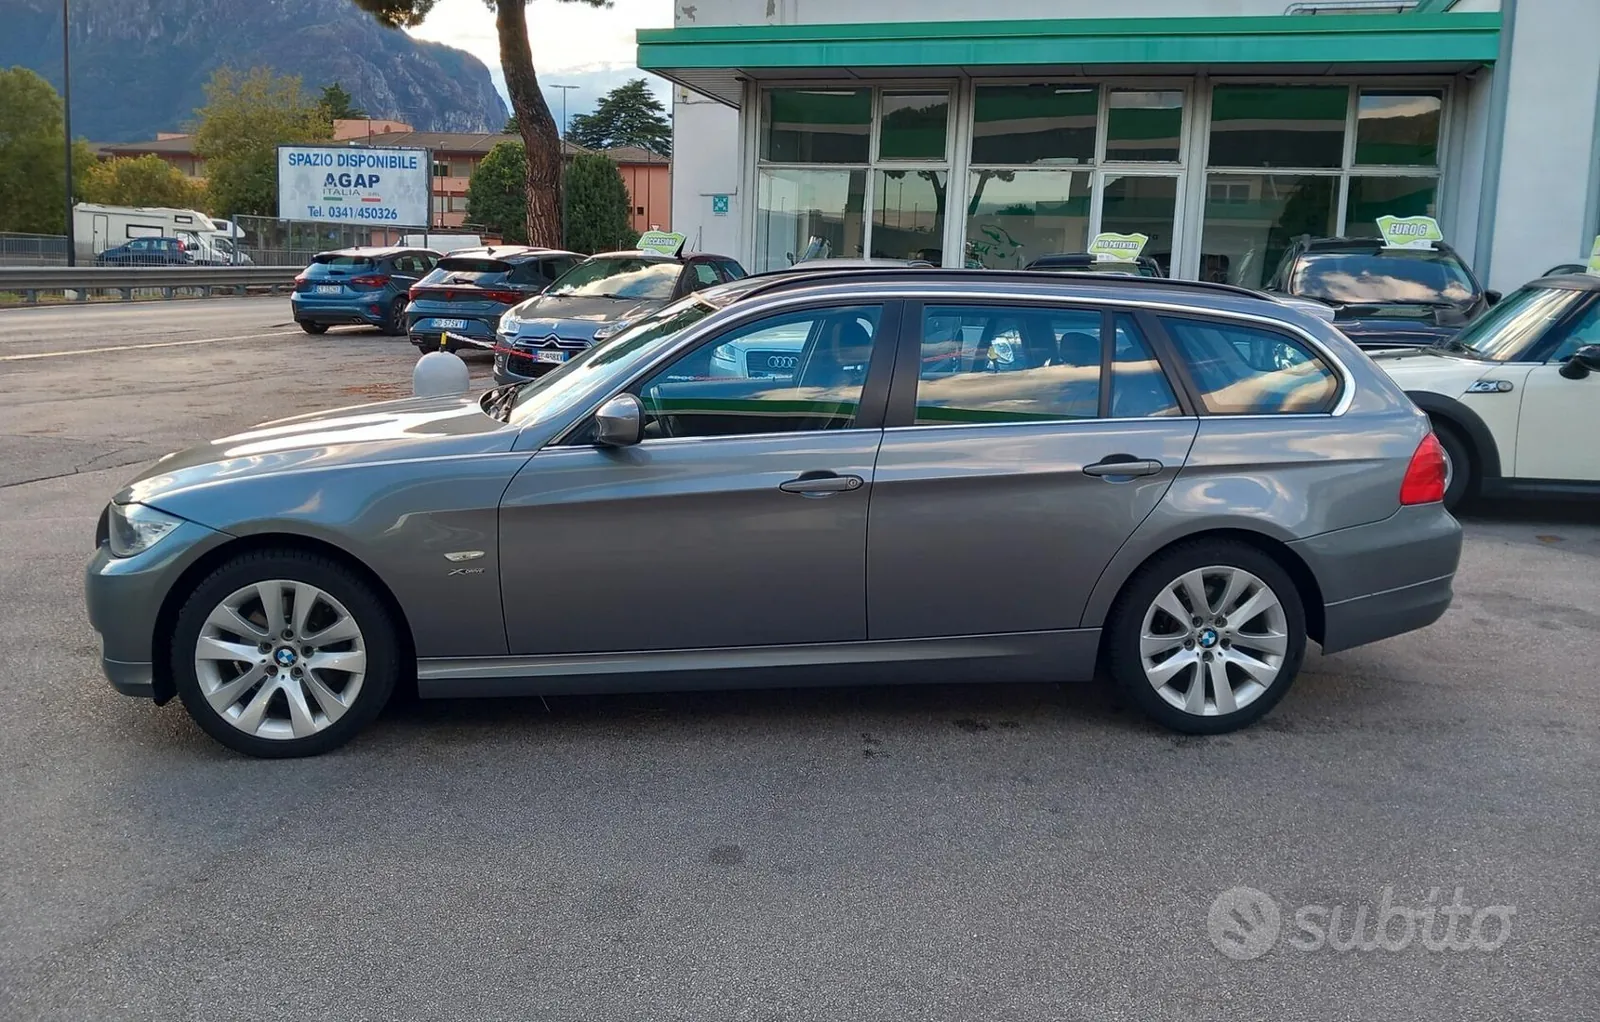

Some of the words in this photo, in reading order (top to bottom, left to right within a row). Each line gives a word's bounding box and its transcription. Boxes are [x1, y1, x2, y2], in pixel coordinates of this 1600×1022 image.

[288, 152, 333, 167] SPAZIO
[337, 154, 417, 169] DISPONIBILE
[323, 172, 380, 188] AGAP
[323, 188, 361, 196] ITALIA
[307, 205, 325, 217] Tel.
[328, 206, 398, 220] 0341/450326
[1389, 222, 1418, 236] EURO
[1417, 223, 1428, 236] 6
